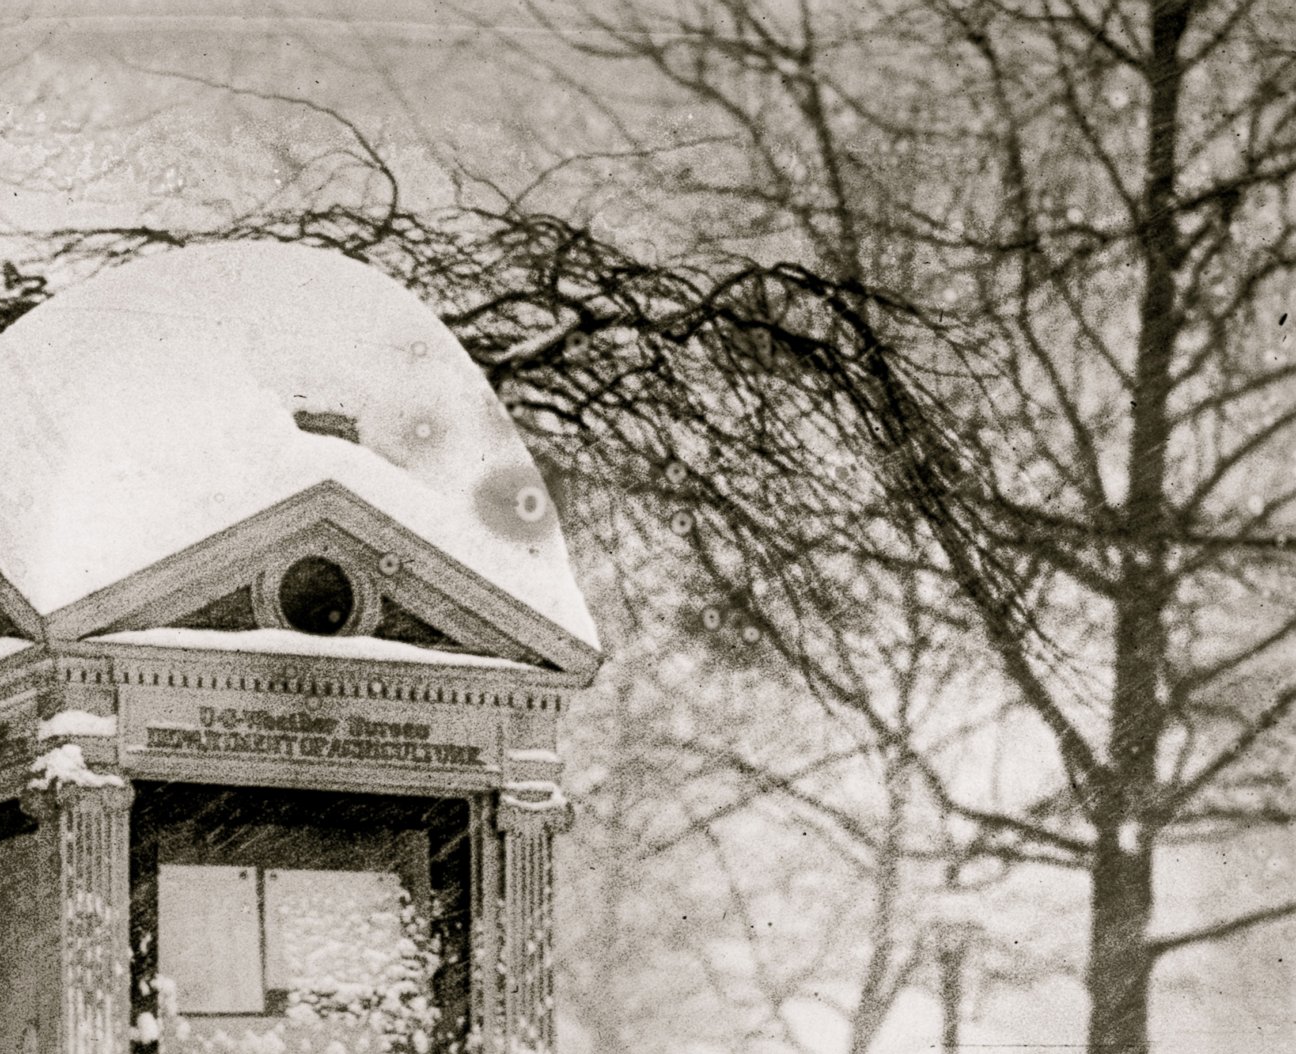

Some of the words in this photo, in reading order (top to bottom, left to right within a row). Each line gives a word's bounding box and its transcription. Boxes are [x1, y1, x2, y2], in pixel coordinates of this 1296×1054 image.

[348, 714, 431, 740] Bureau
[146, 727, 299, 756] DEPARTMENT
[300, 736, 330, 758] OF
[328, 738, 485, 765] AGRICULTURE
